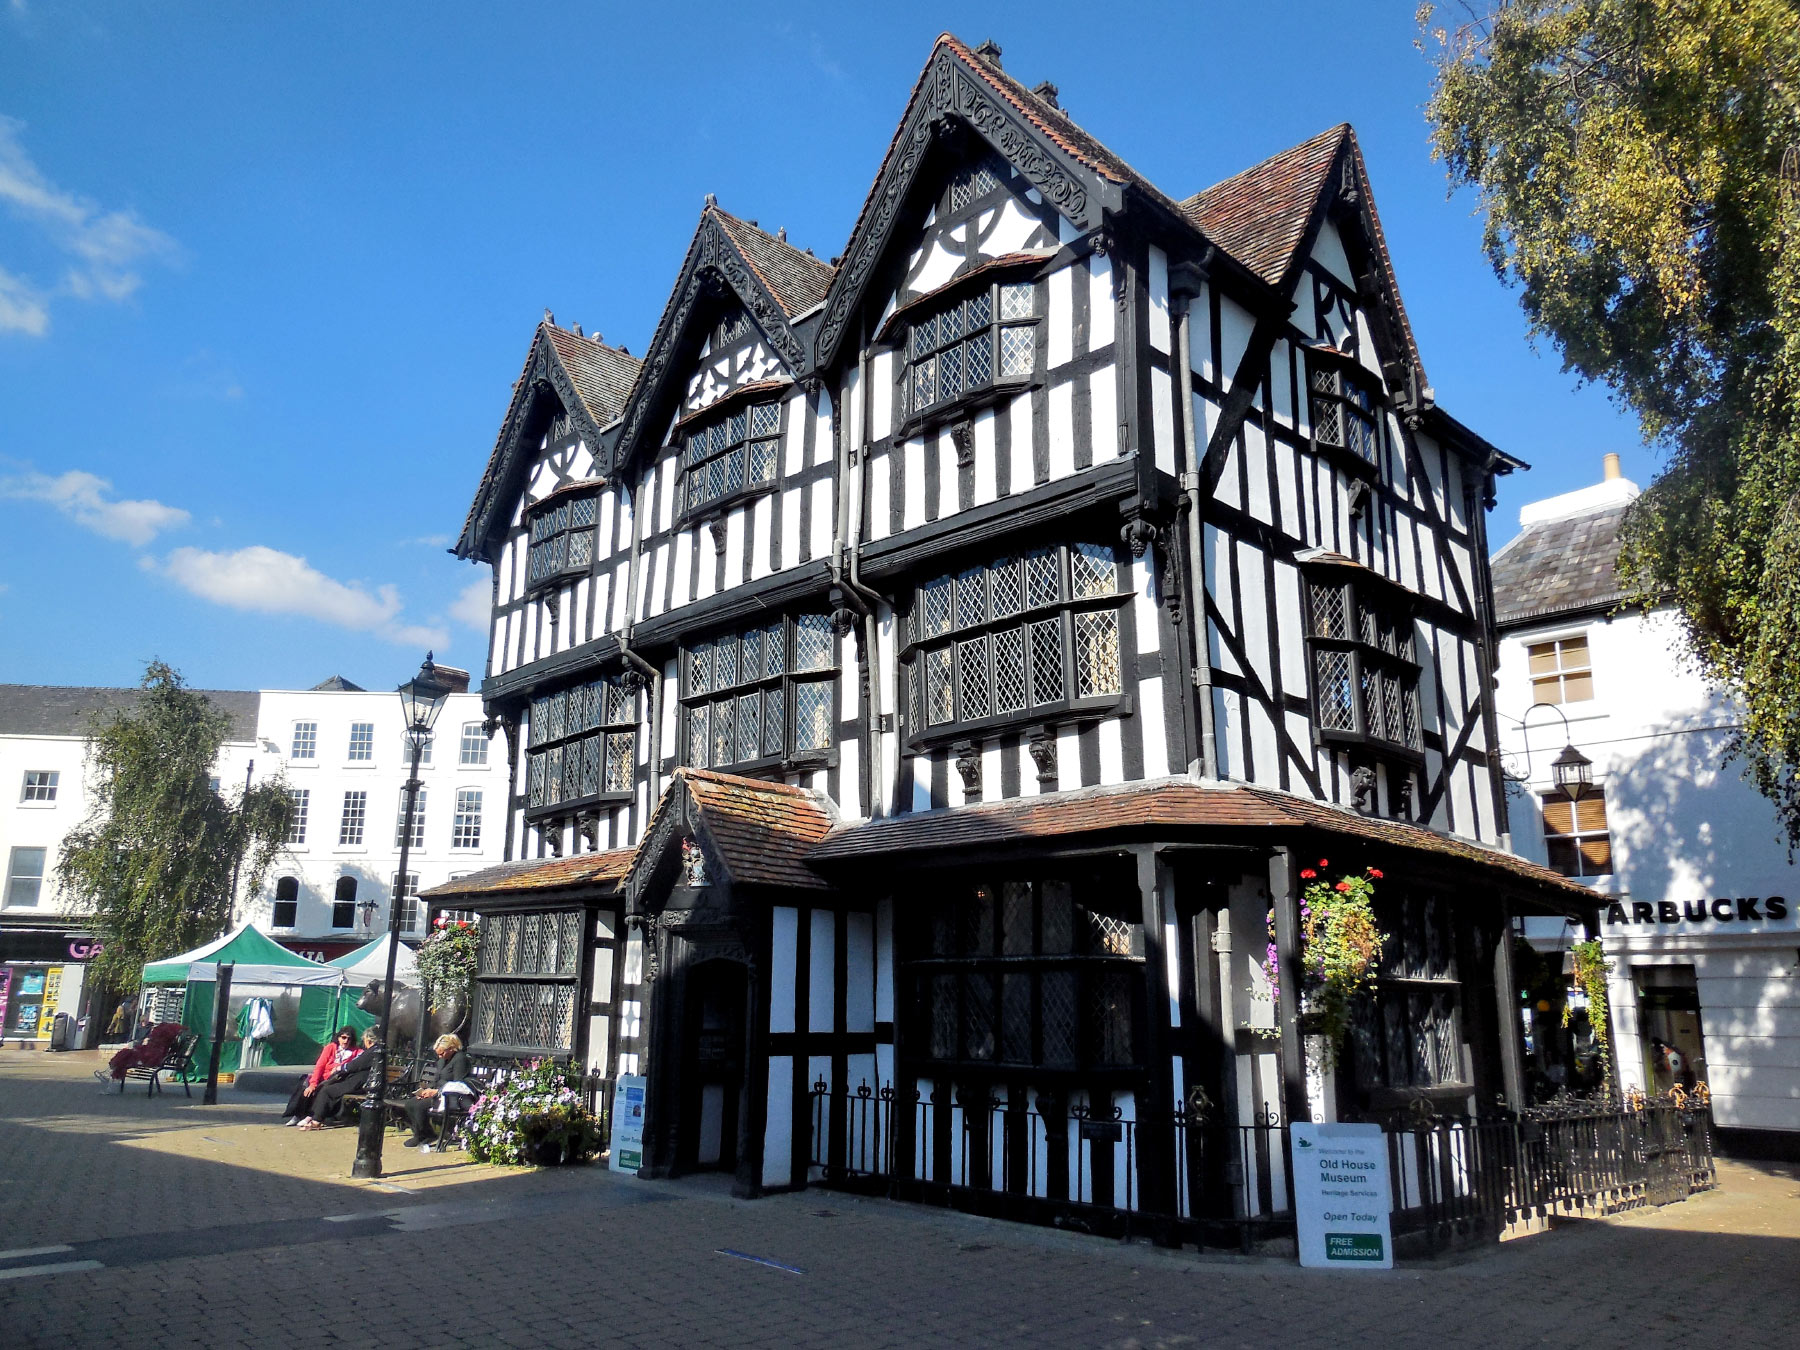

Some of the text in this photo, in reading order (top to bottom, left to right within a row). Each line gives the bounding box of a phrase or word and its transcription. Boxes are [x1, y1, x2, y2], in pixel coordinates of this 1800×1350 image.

[1566, 896, 1788, 925] ARBUCKS
[1320, 1159, 1376, 1170] Old House
[1320, 1173, 1367, 1183] Museum
[1323, 1212, 1378, 1223] Open Today
[1329, 1237, 1353, 1246] FREE
[1330, 1248, 1380, 1257] ADMISSION
